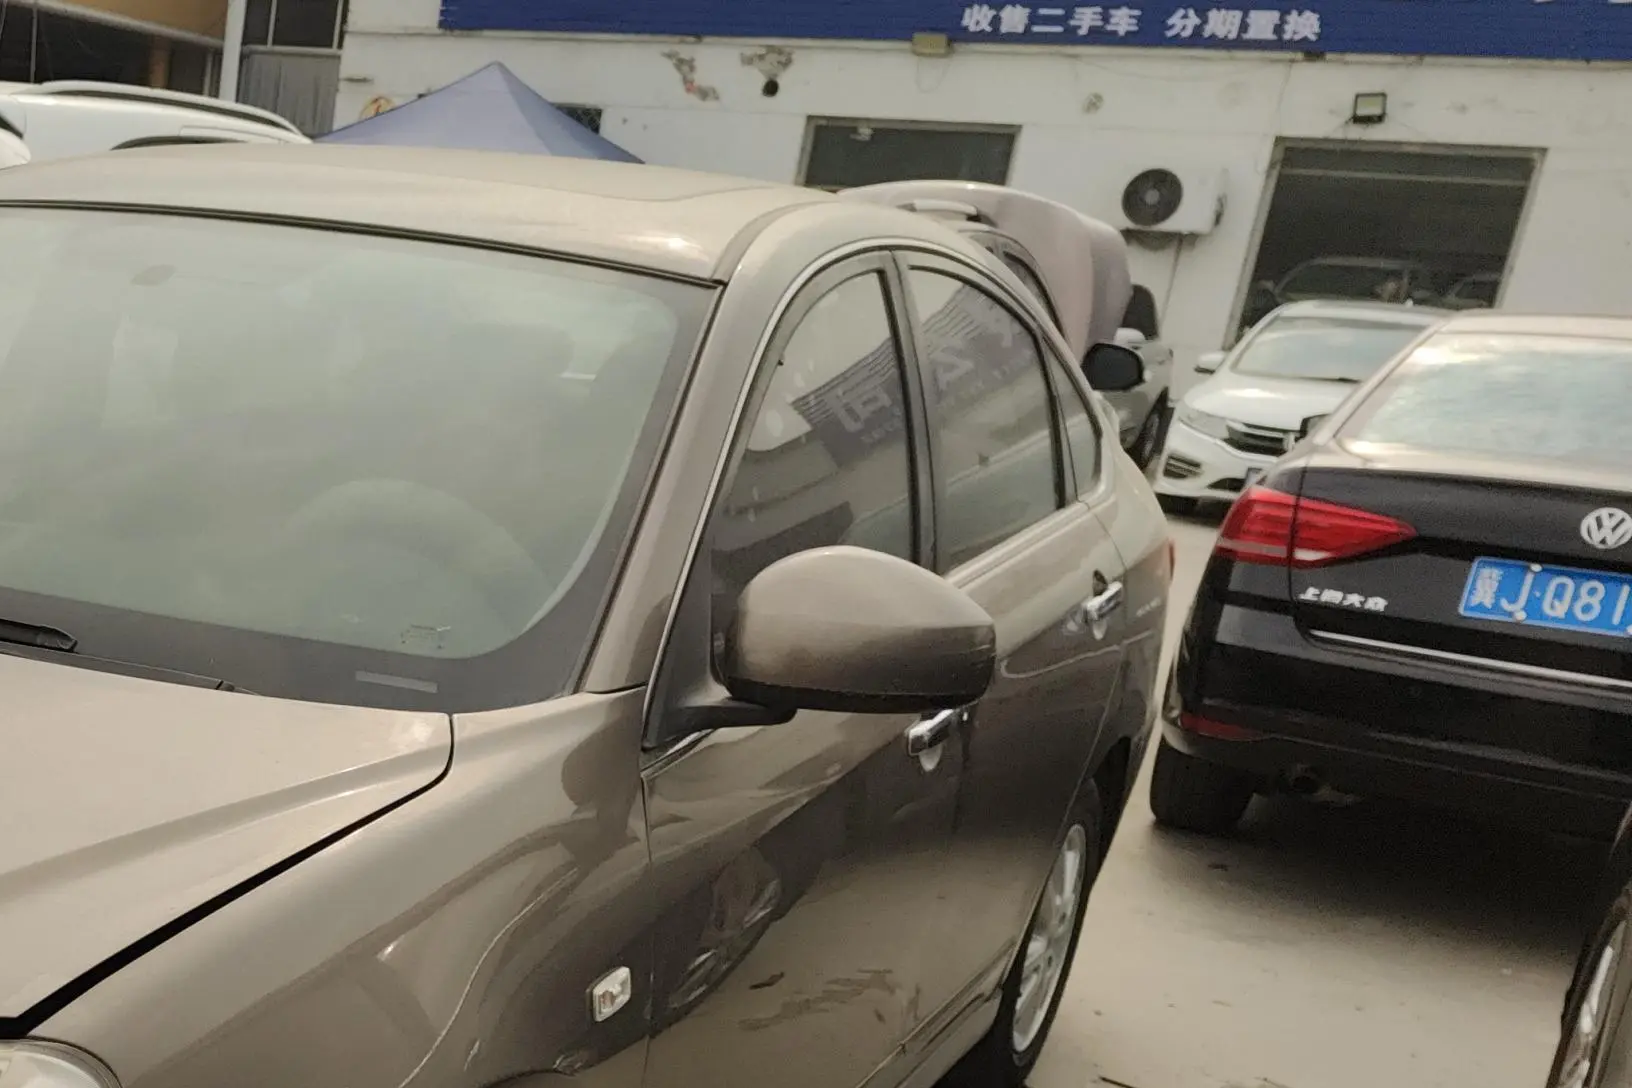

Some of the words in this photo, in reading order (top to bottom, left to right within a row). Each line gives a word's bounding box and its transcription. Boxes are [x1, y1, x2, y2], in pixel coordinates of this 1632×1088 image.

[962, 4, 1142, 36] 收售二手车
[1165, 7, 1322, 41] 分期置换
